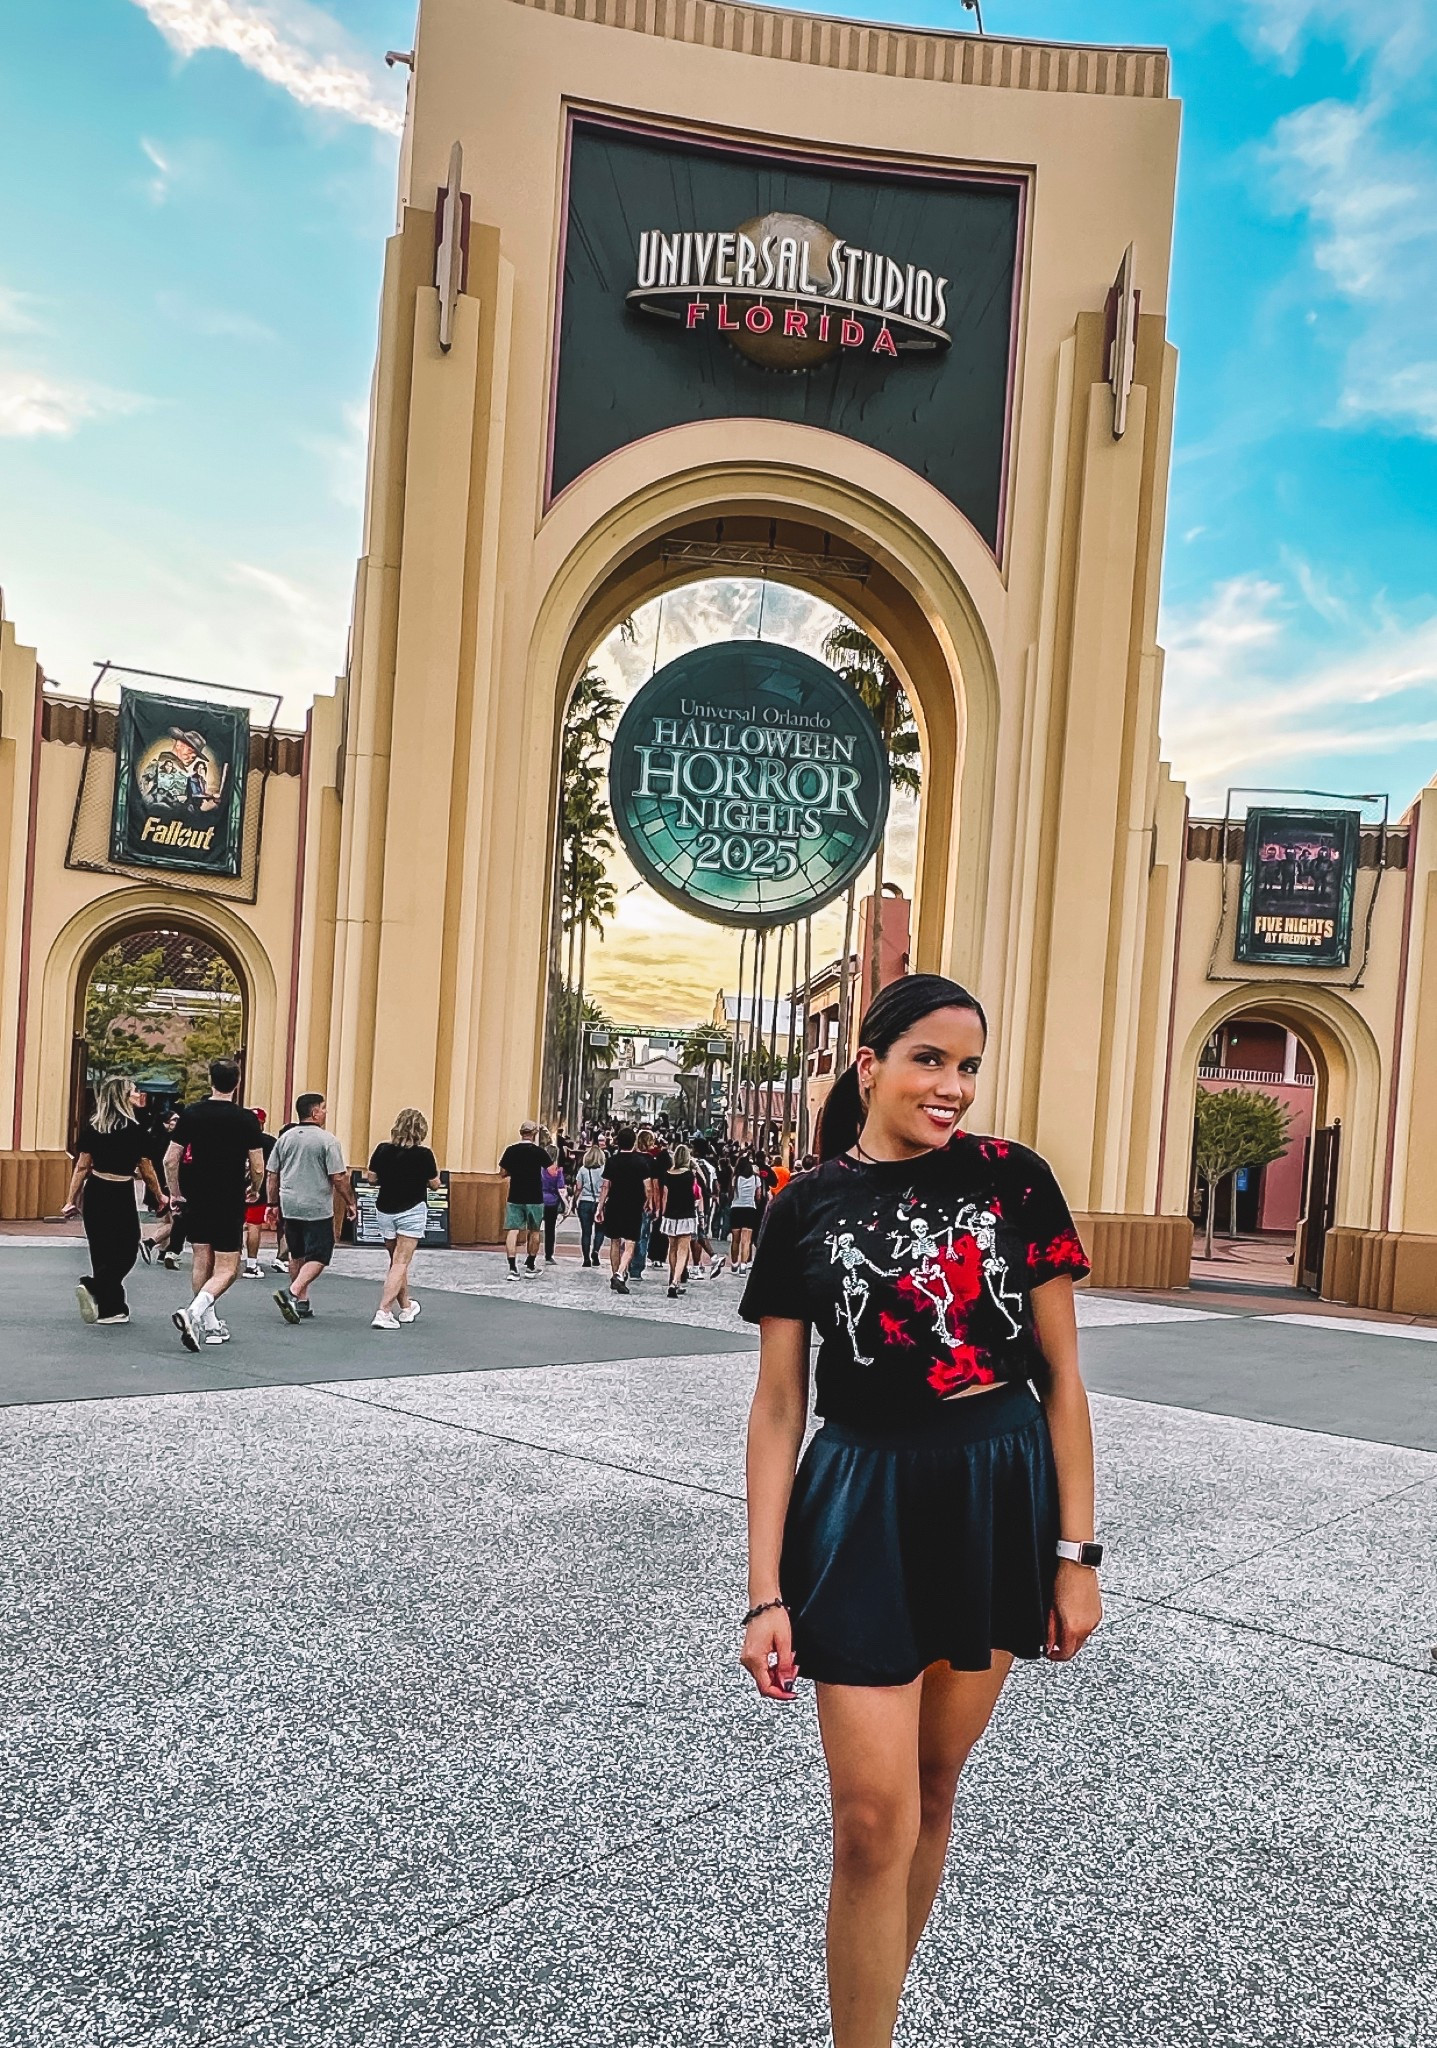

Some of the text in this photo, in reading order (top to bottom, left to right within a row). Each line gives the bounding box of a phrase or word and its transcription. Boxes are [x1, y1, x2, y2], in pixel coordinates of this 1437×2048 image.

[637, 229, 950, 328] UNIVERSAL STUDIOS
[686, 303, 898, 357] FLORIDA
[680, 699, 831, 729] Universal Orlando
[651, 717, 858, 763] HALLOWEEN
[632, 745, 869, 829] HORROR
[140, 816, 215, 850] Fallout
[676, 797, 822, 840] NIGHTS
[695, 833, 800, 881] 2025
[1254, 916, 1335, 938] FIVE NIGHTS
[1264, 932, 1322, 946] AT FREDDY'S
